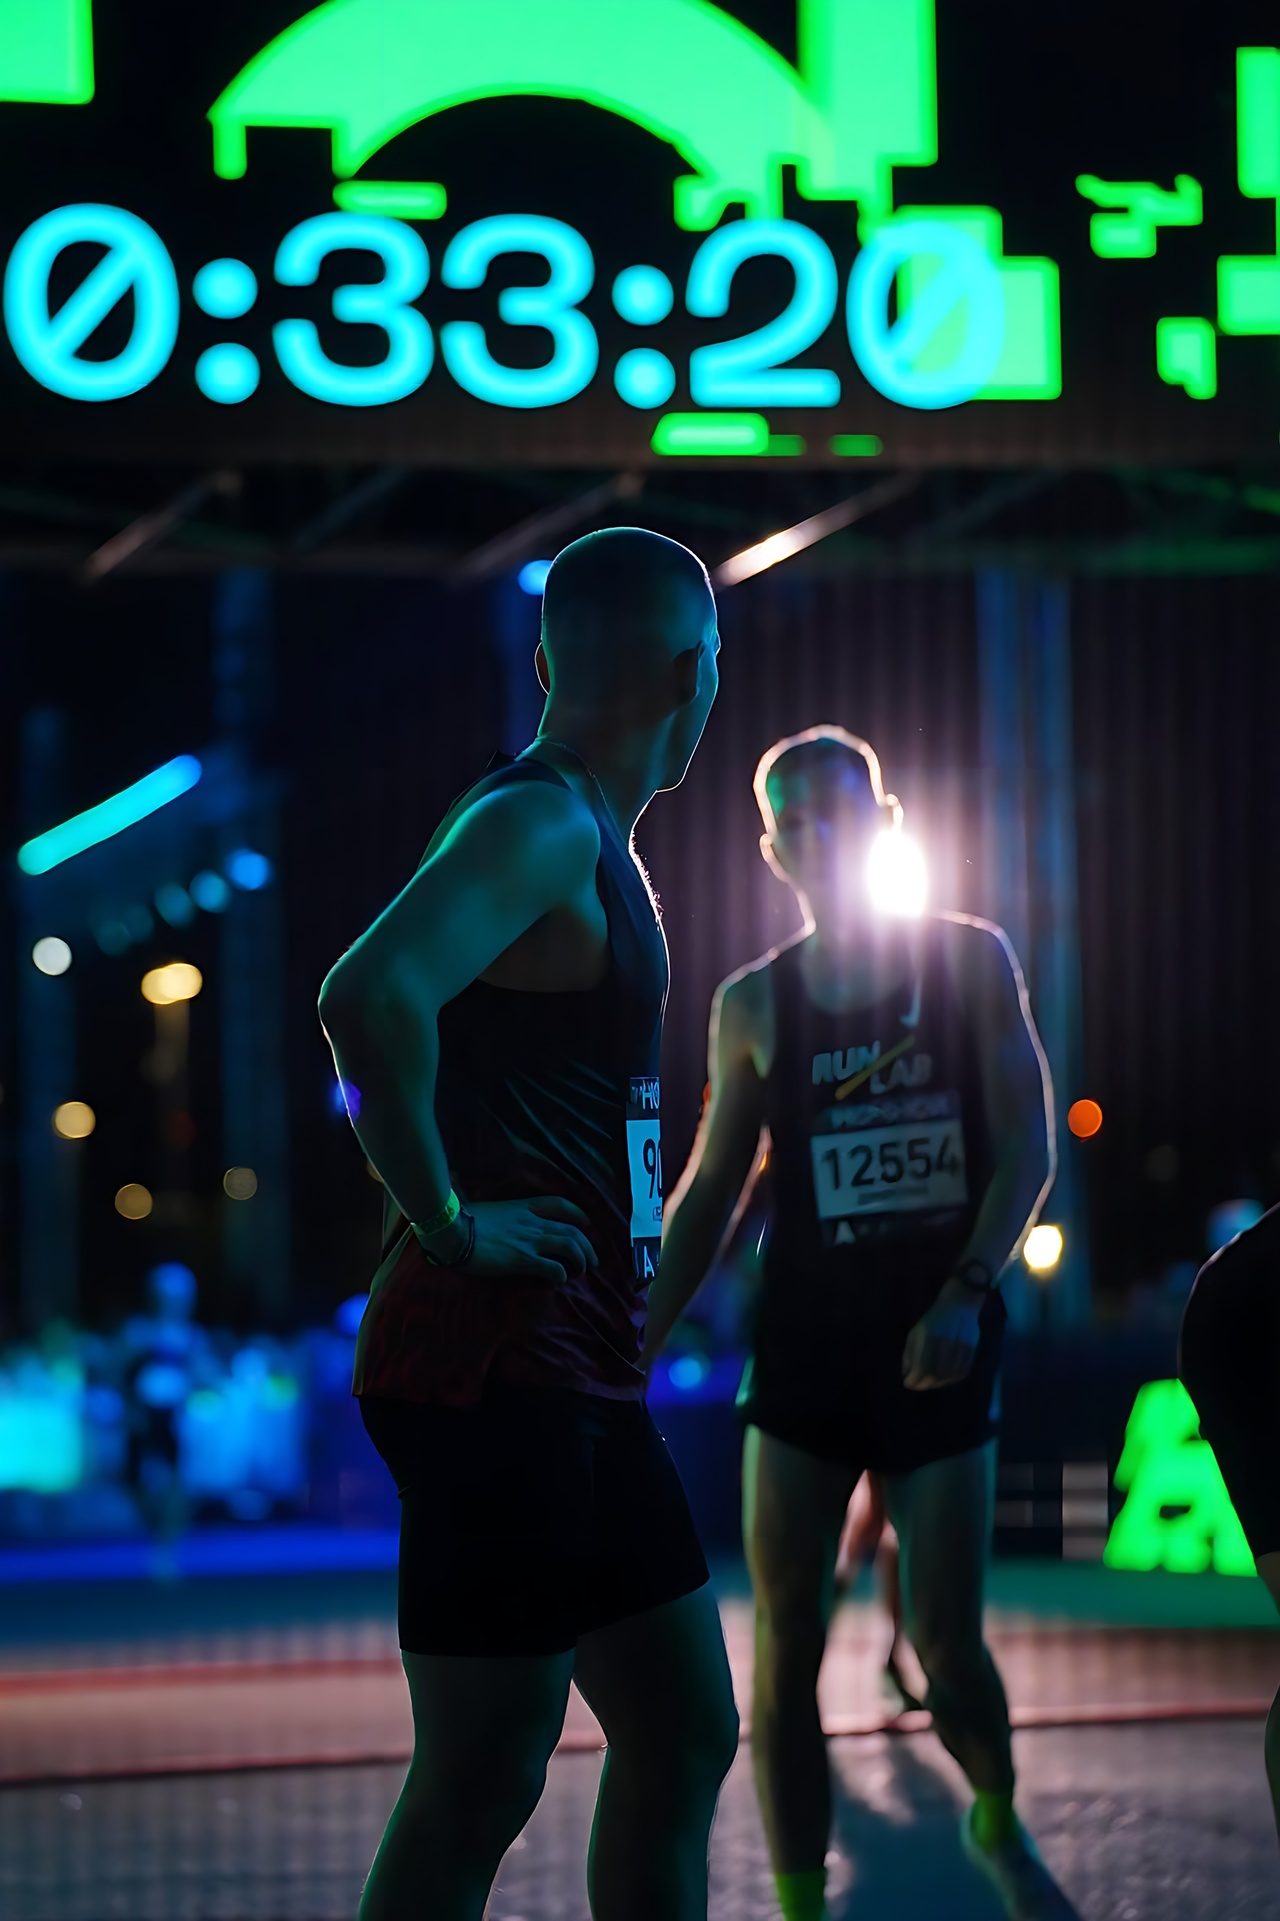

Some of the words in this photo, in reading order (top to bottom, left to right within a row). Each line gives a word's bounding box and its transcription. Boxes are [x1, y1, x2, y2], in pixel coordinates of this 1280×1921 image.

[3, 202, 1006, 411] 0:33:20
[812, 1040, 880, 1086] RUN
[822, 1134, 959, 1191] 12554
